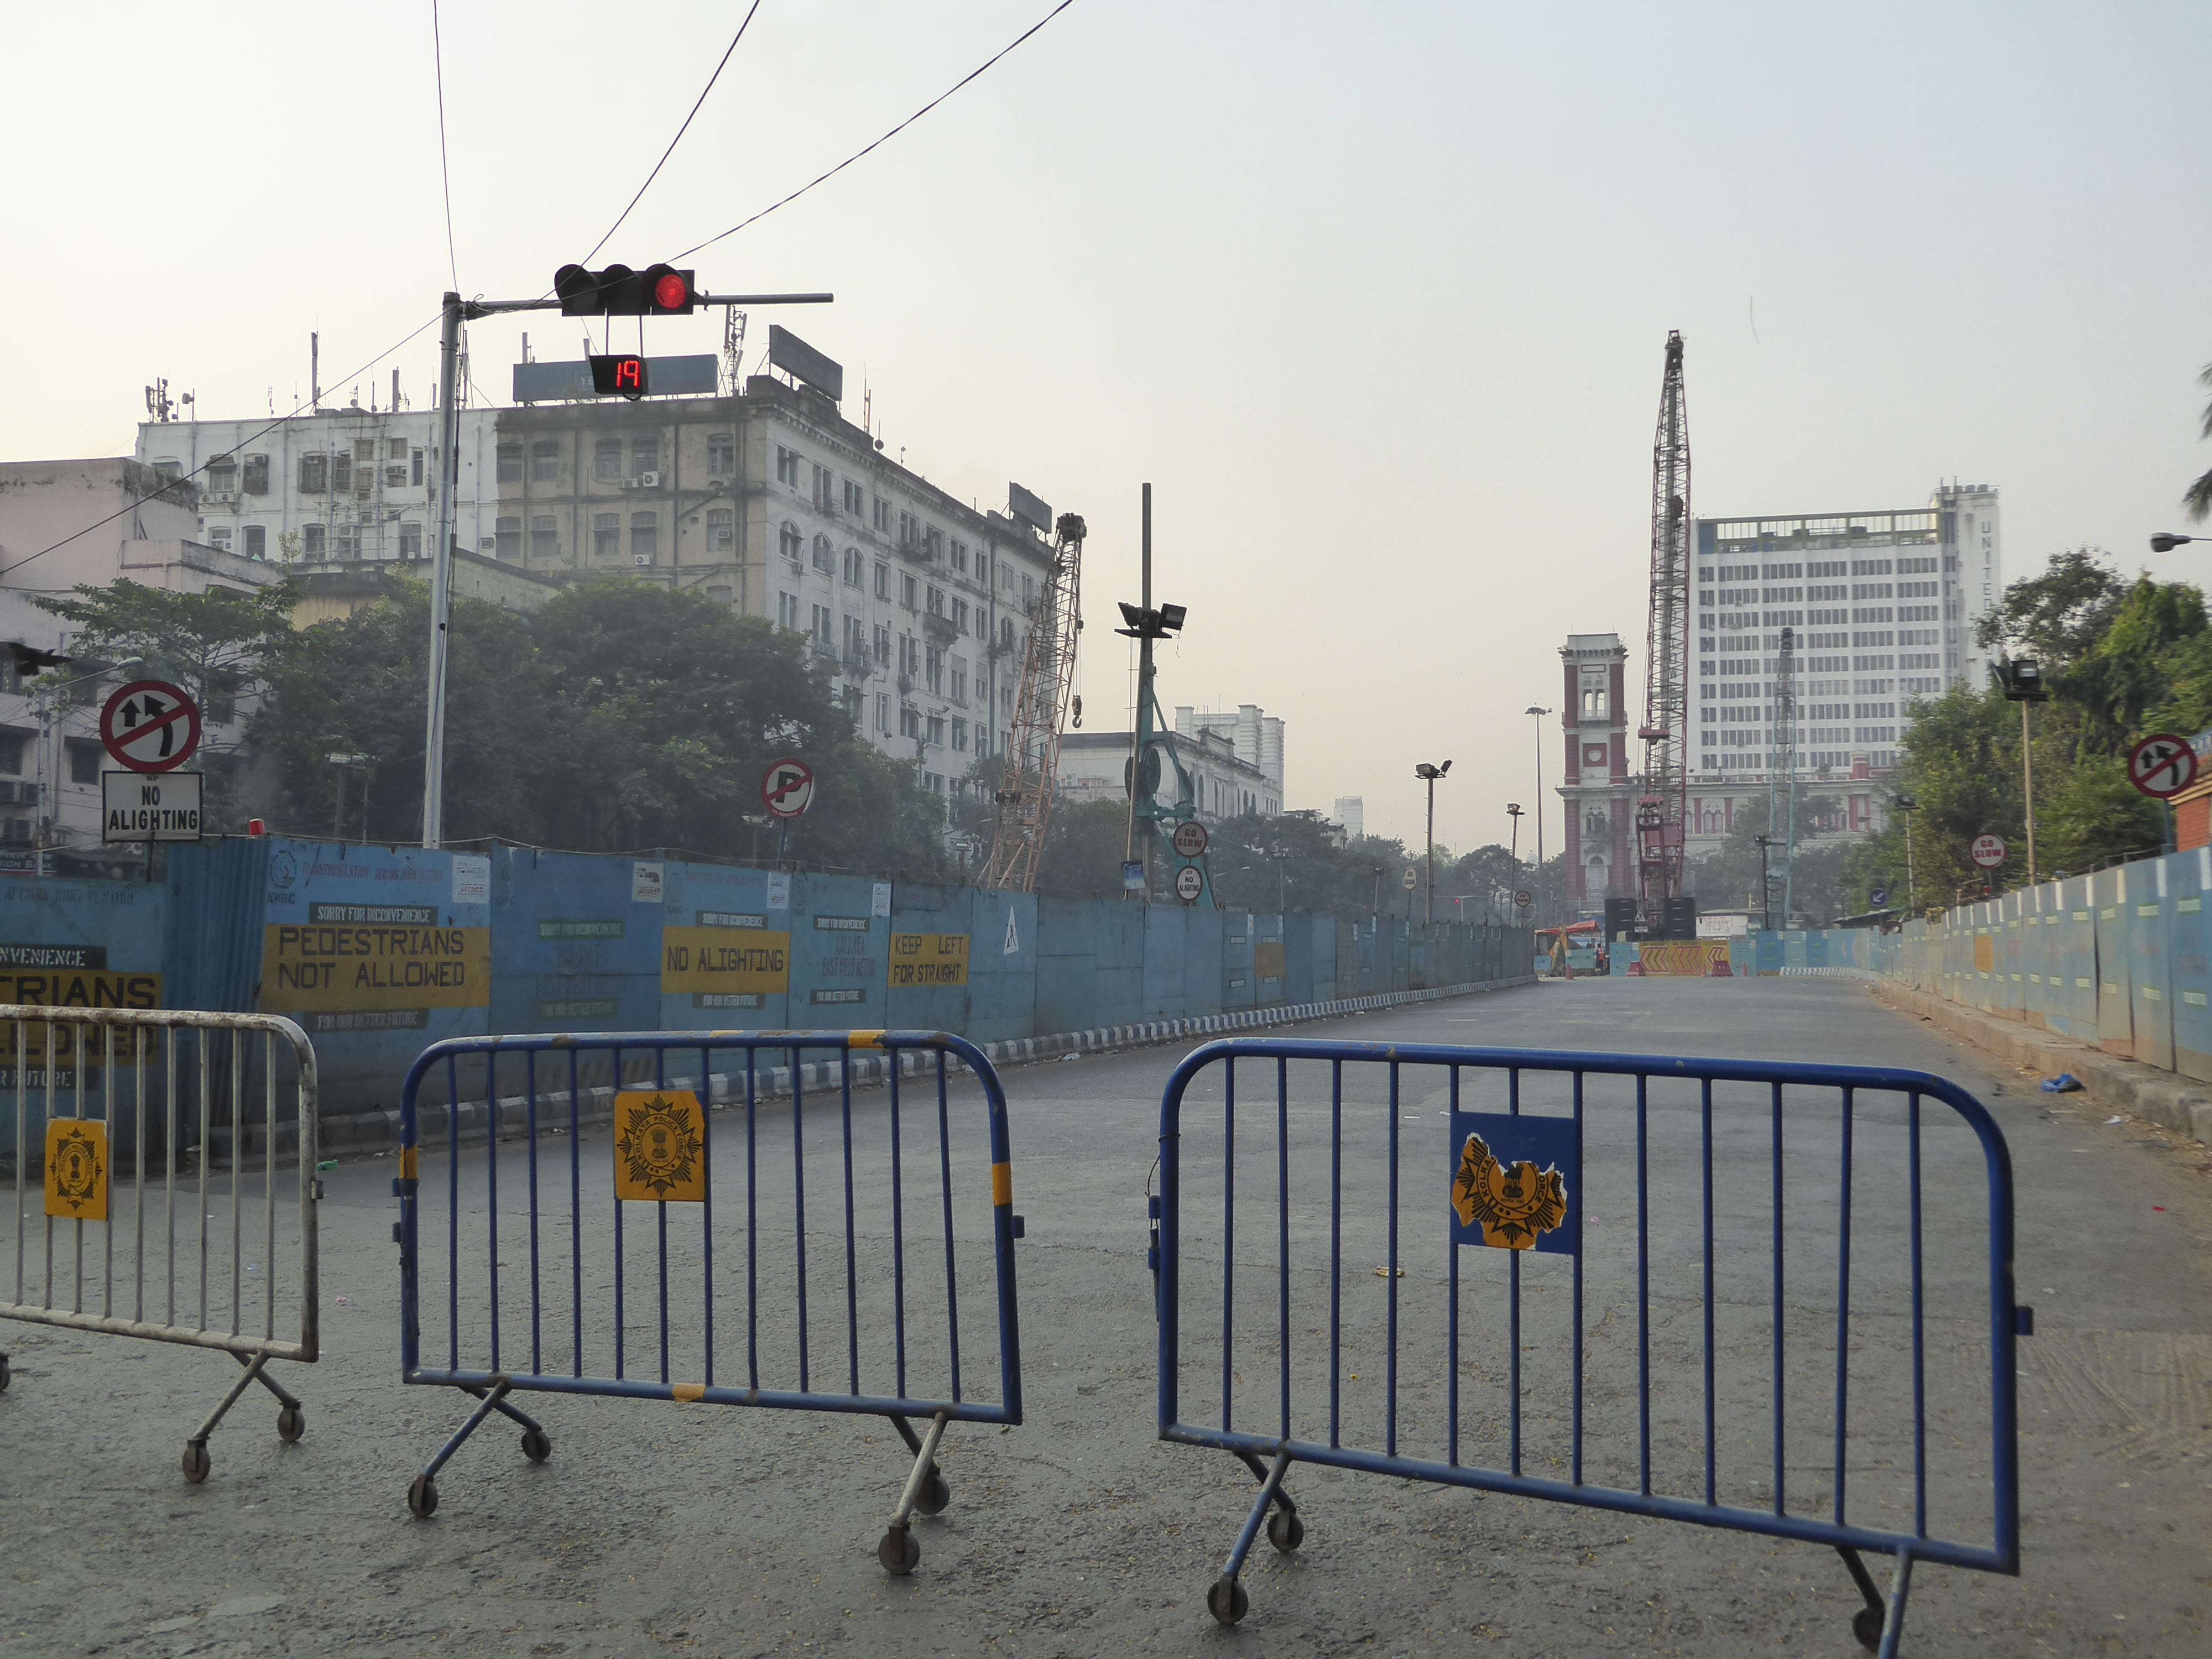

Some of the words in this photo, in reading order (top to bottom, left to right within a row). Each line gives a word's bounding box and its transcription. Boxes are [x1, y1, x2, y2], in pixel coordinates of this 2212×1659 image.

[616, 361, 639, 387] 19
[142, 785, 160, 806] NO
[109, 810, 197, 830] ALIGHTING
[1177, 838, 1202, 847] SLOW
[1185, 828, 1197, 837] GO
[1974, 849, 2001, 858] SLOW
[268, 893, 296, 904] KMRC
[318, 906, 347, 921] SORRY
[348, 907, 366, 921] FOR
[367, 907, 430, 923] INCONVENIENCE
[279, 927, 464, 956] PEDESTRIANS
[895, 935, 922, 956] KEEP
[938, 936, 964, 955] LEFT
[667, 946, 688, 971] NO
[697, 947, 784, 972] ALIGHTING
[279, 962, 336, 989] NOT
[354, 961, 465, 988] ALLOWED
[894, 964, 914, 983] FOR
[917, 963, 962, 983] STRAIGHT
[318, 1015, 335, 1030] FOR
[337, 1014, 353, 1029] OUR
[355, 1013, 386, 1027] BETTER
[388, 1011, 418, 1026] FUTURE
[0, 1024, 154, 1057] LOWED
[654, 1116, 679, 1130] POLICE
[635, 1119, 651, 1160] KOLKATA
[676, 1133, 685, 1161] FORCE
[1480, 1156, 1495, 1197] KOLKA
[1535, 1176, 1546, 1203] ORCE
